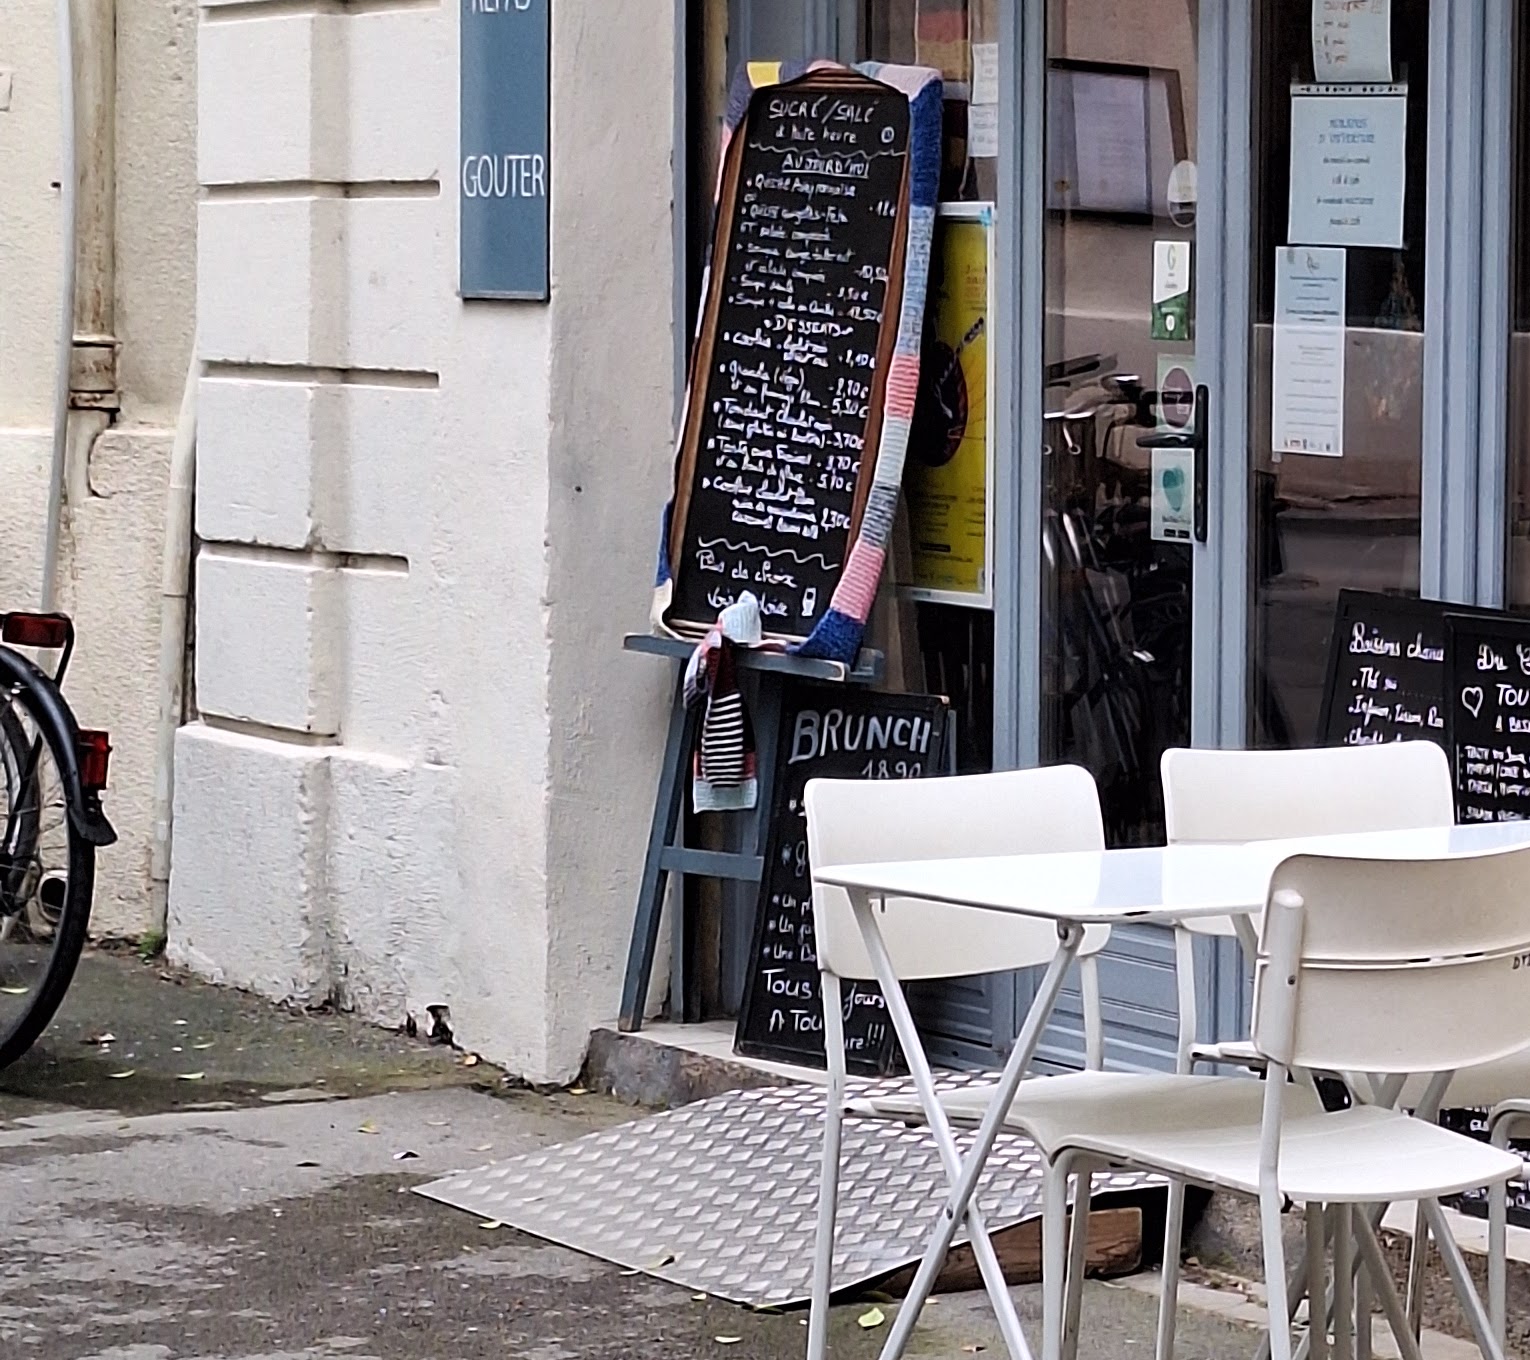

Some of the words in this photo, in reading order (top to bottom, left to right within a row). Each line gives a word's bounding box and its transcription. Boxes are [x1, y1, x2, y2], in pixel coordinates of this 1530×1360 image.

[462, 153, 546, 198] GOUTER
[1476, 643, 1508, 671] Du
[787, 708, 932, 765] BRUNCH
[761, 967, 813, 1000] Tous
